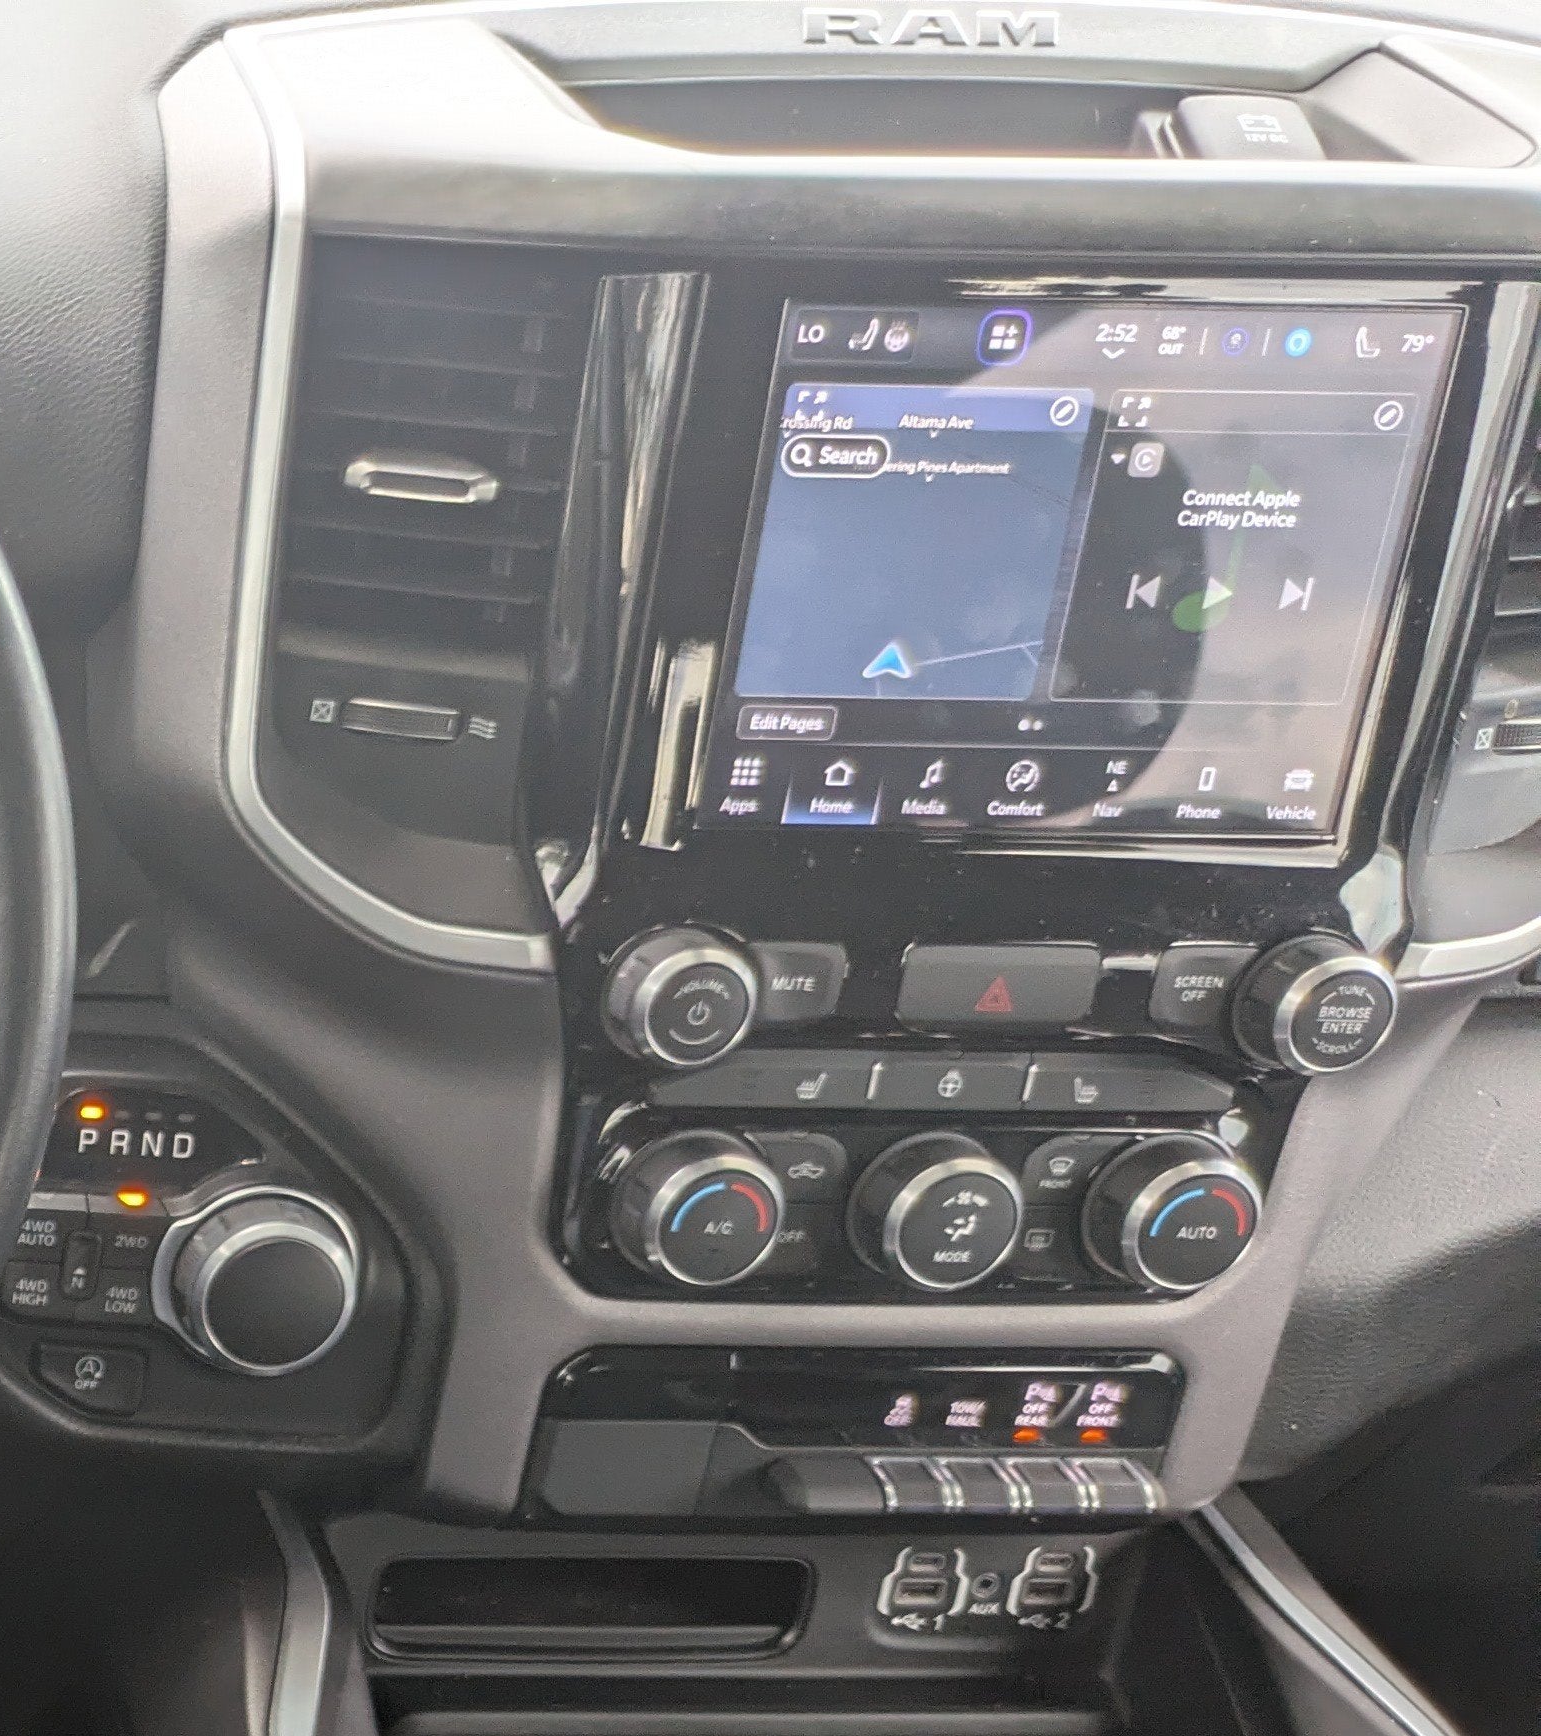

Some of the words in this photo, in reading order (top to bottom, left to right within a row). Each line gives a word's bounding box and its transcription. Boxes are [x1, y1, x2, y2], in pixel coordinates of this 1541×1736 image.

[802, 7, 1059, 47] RAM
[797, 325, 826, 343] LO
[1095, 324, 1138, 342] 2:52
[780, 417, 832, 432] rossing
[947, 415, 974, 429] Ave
[819, 445, 877, 465] Search
[1182, 490, 1251, 507] Connect
[1252, 490, 1301, 510] Apple
[1177, 510, 1240, 530] CarPlay
[1242, 511, 1297, 529] Device
[750, 714, 778, 731] Edit
[780, 715, 824, 734] Pages
[1106, 761, 1128, 775] NE
[719, 798, 758, 815] Apps
[810, 798, 853, 814] Home
[901, 799, 946, 815] Media
[987, 801, 1044, 817] Comfort
[1092, 804, 1122, 818] Nav
[1176, 805, 1221, 820] Phone
[1266, 805, 1316, 821] Vehicle
[771, 976, 816, 992] MUTE
[1174, 976, 1224, 988] SCREEN
[1181, 990, 1207, 1002] OFF
[1319, 1006, 1373, 1019] BROWSE
[1321, 1022, 1363, 1034] ENTER
[78, 1129, 99, 1154] P
[110, 1130, 129, 1156] R
[141, 1132, 164, 1158] N
[173, 1134, 195, 1159] D
[22, 1219, 57, 1234] 4WD
[704, 1220, 734, 1236] A/C
[1176, 1225, 1217, 1240] AUTO
[17, 1232, 57, 1248] AUTO
[115, 1233, 148, 1249] 2WD
[15, 1278, 48, 1293] 4WD
[71, 1275, 85, 1290] N
[12, 1291, 47, 1307] HIGH
[105, 1287, 138, 1301] 4WD
[104, 1300, 136, 1315] LOW
